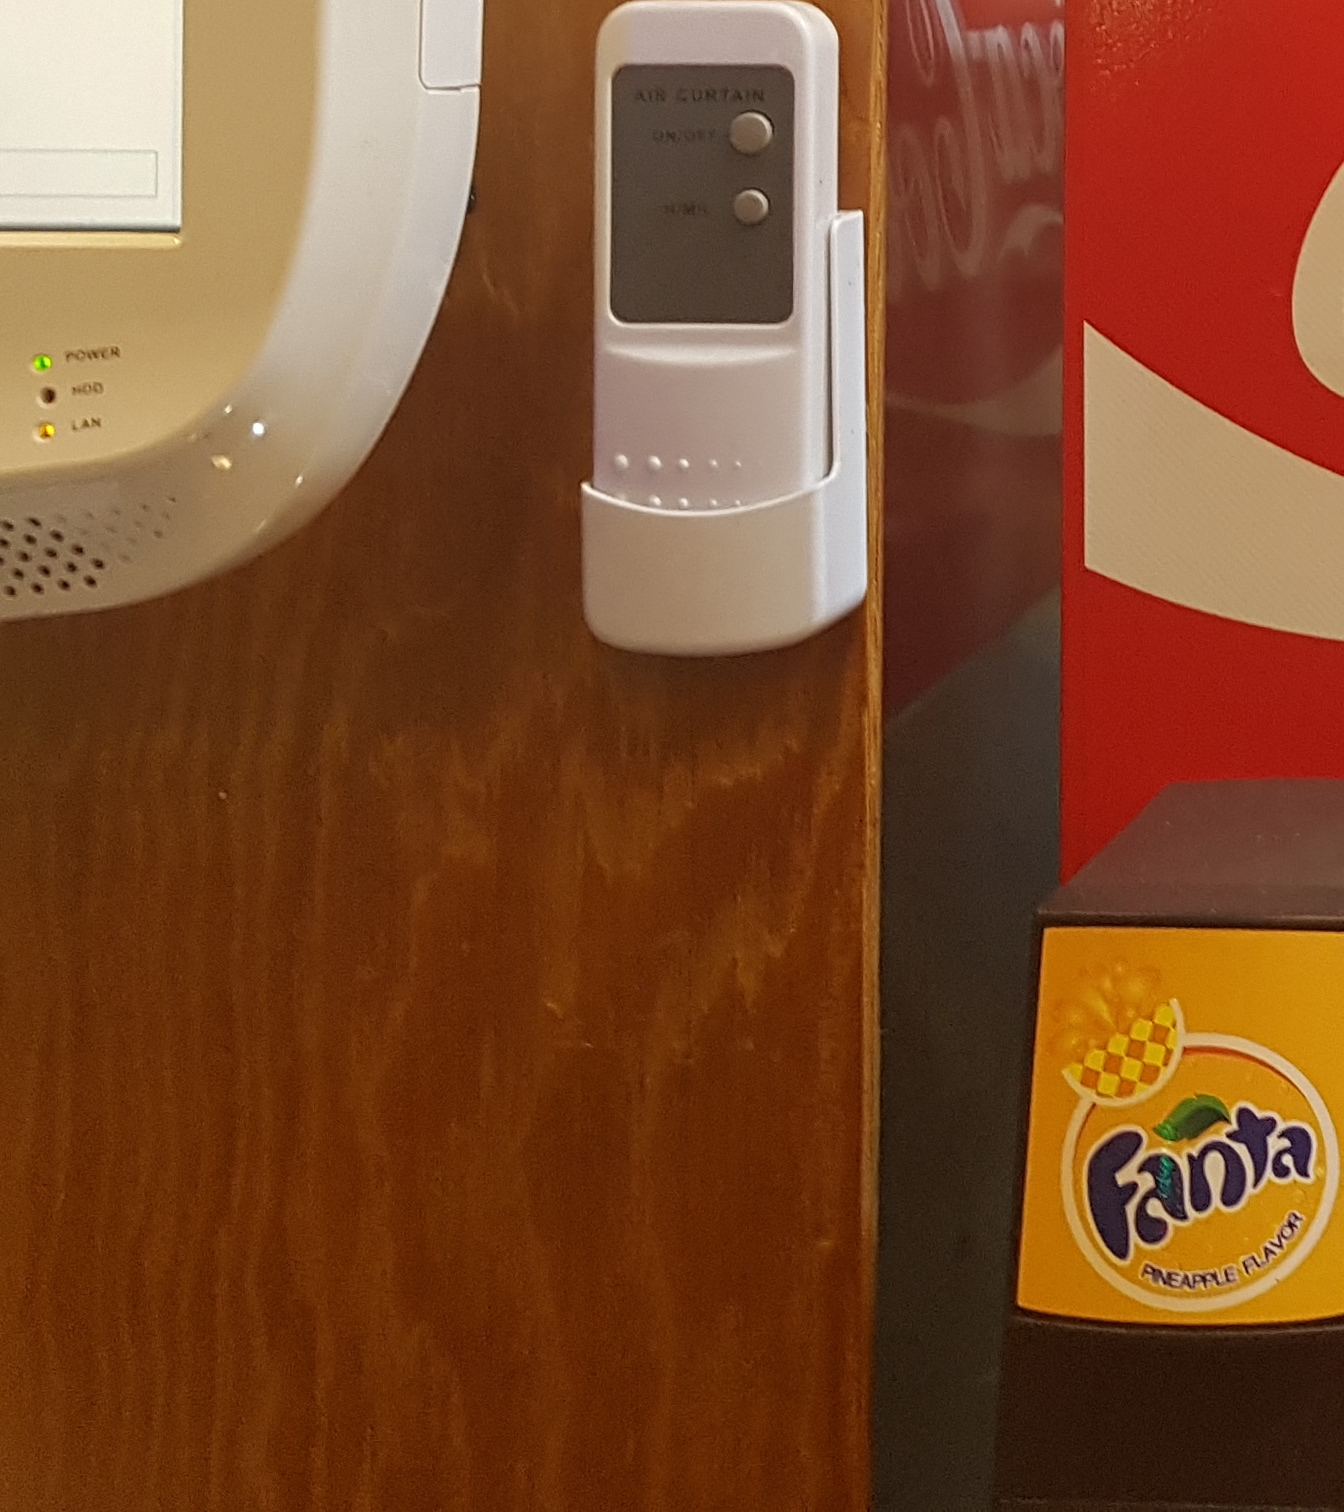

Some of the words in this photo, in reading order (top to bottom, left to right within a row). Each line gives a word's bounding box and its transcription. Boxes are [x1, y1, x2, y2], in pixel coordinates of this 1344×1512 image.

[634, 89, 667, 103] AIR
[676, 88, 765, 103] CURTAIN
[63, 346, 120, 361] POWER
[72, 418, 101, 431] LAN
[1083, 1105, 1315, 1262] Fanta
[1141, 1263, 1238, 1290] PINEAPPLE
[1241, 1210, 1304, 1275] FLAVOR
